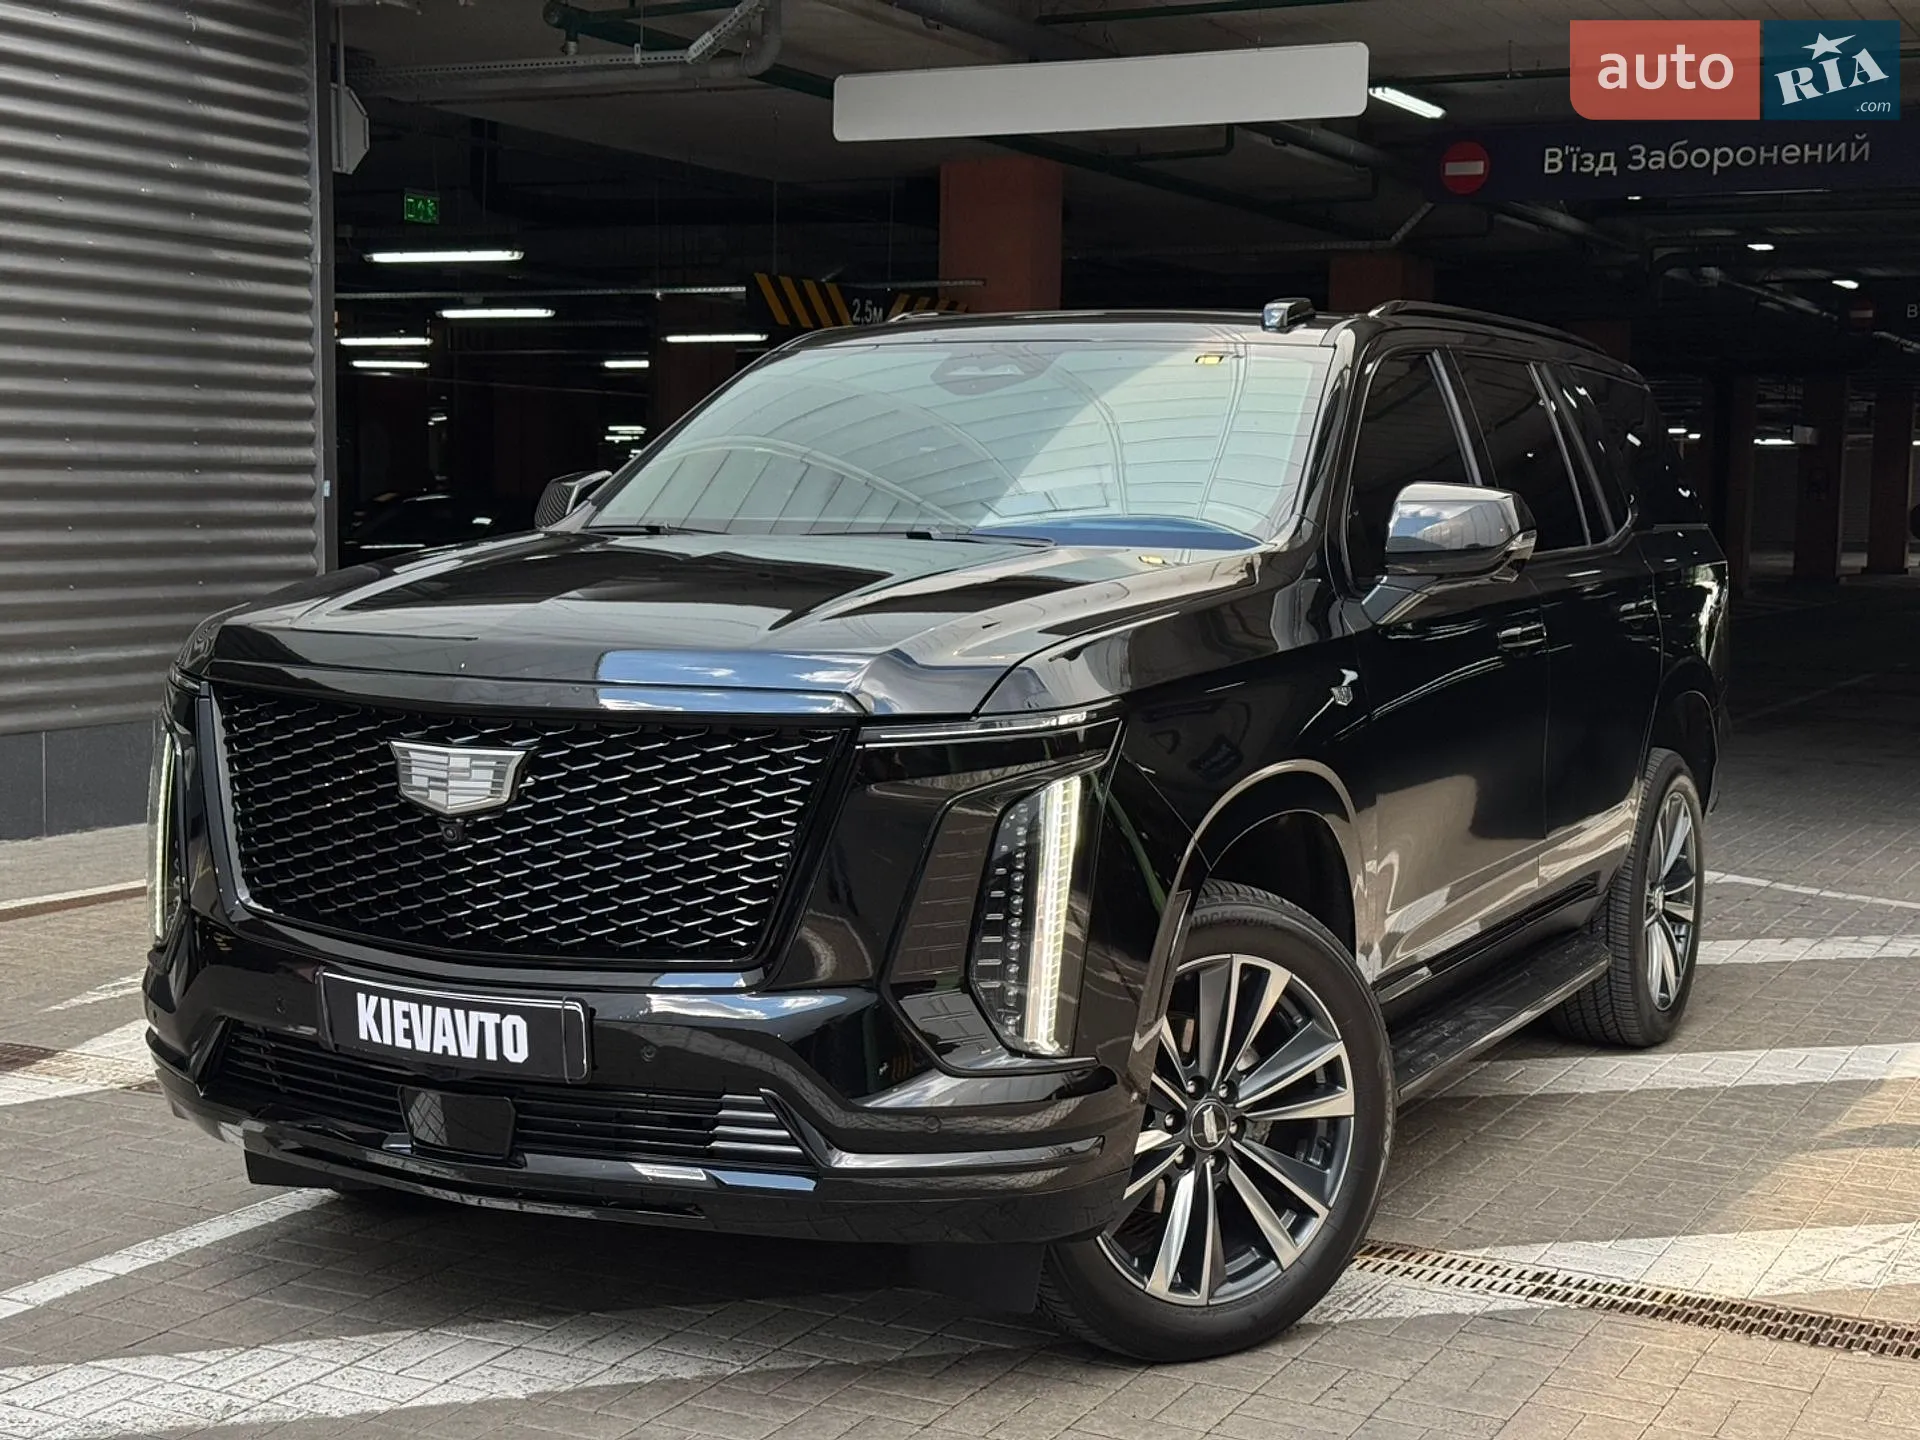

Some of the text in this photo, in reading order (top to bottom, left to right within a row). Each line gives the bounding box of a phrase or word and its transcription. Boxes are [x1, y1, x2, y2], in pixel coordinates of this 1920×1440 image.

[1544, 134, 1871, 177] В'їзд Заборонений
[357, 992, 529, 1064] KIEVAVTO
